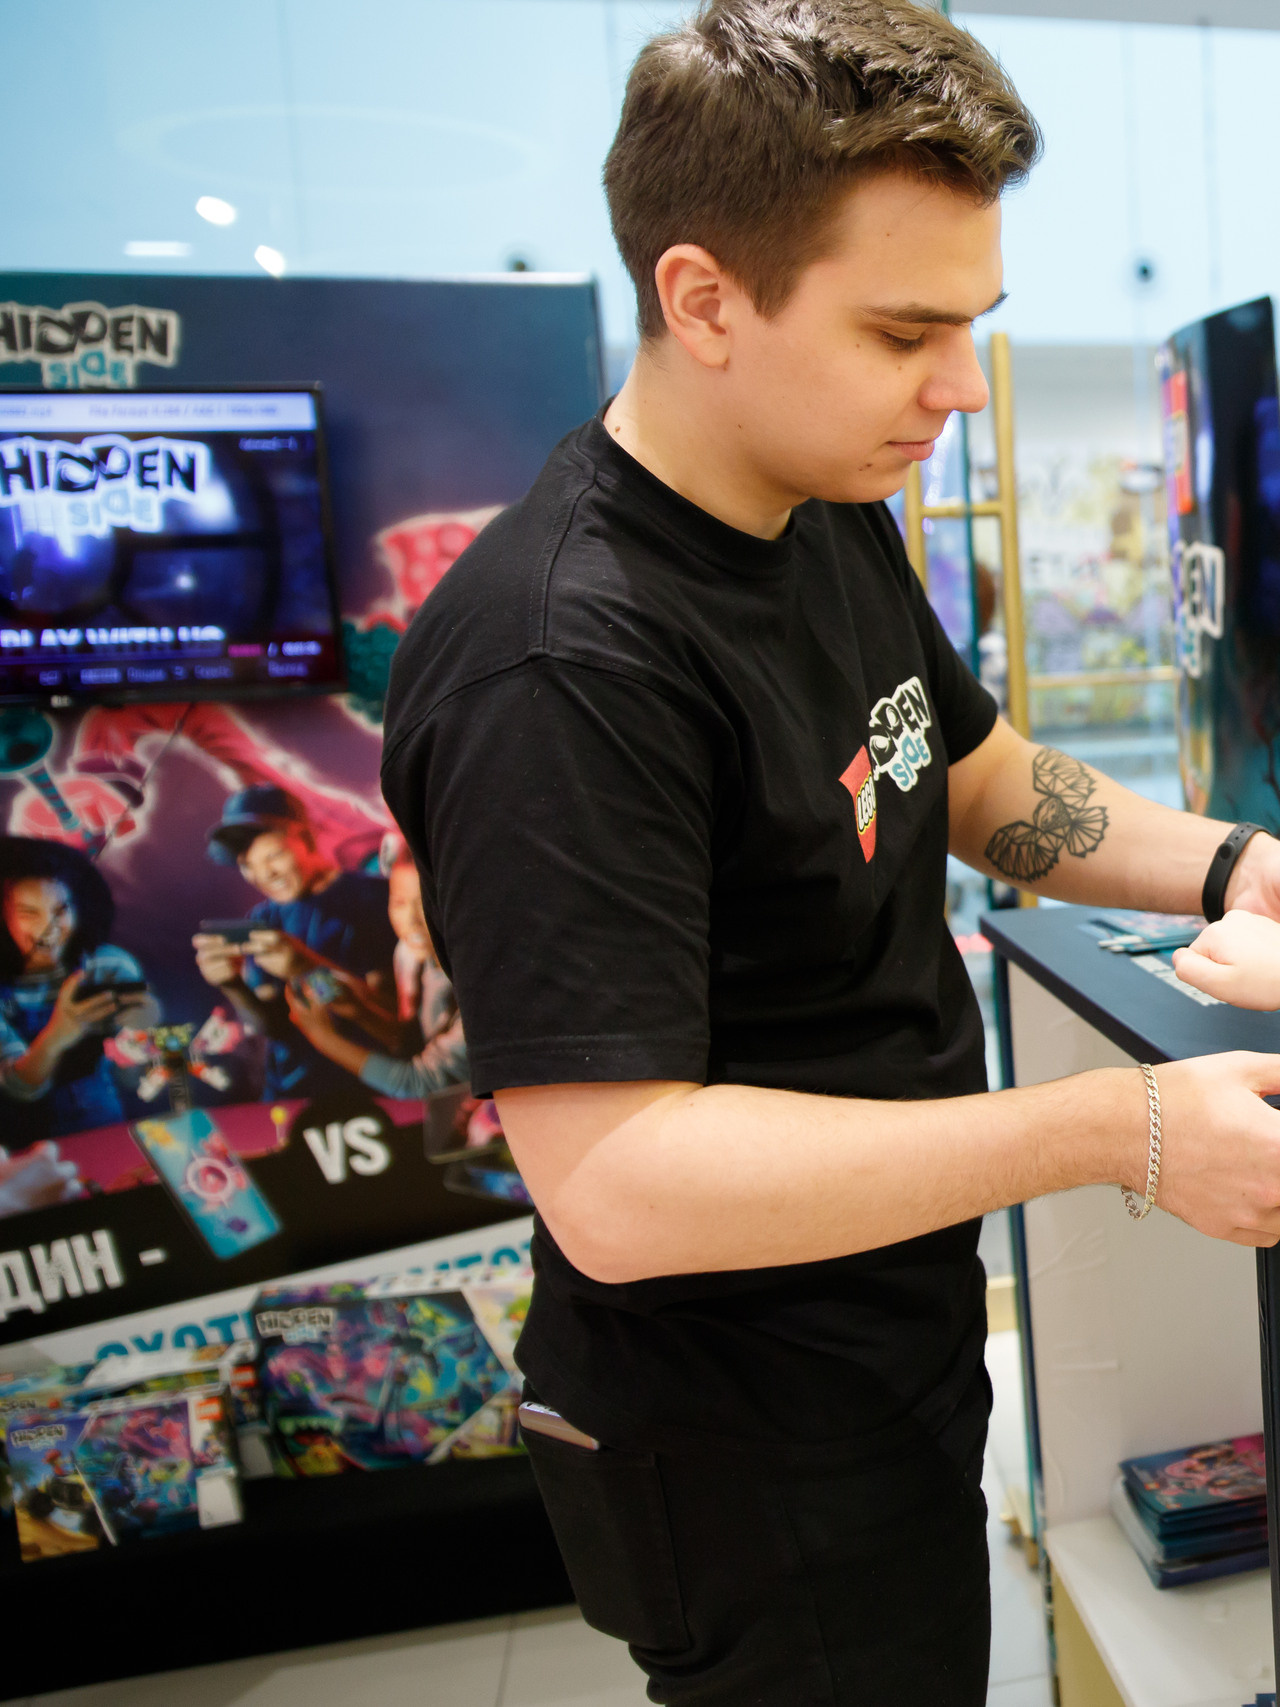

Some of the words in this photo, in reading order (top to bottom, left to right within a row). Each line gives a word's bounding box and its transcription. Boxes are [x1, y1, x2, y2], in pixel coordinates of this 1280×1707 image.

[0, 443, 200, 495] HIDDEN
[891, 735, 930, 787] SIDE
[303, 1116, 391, 1185] VS
